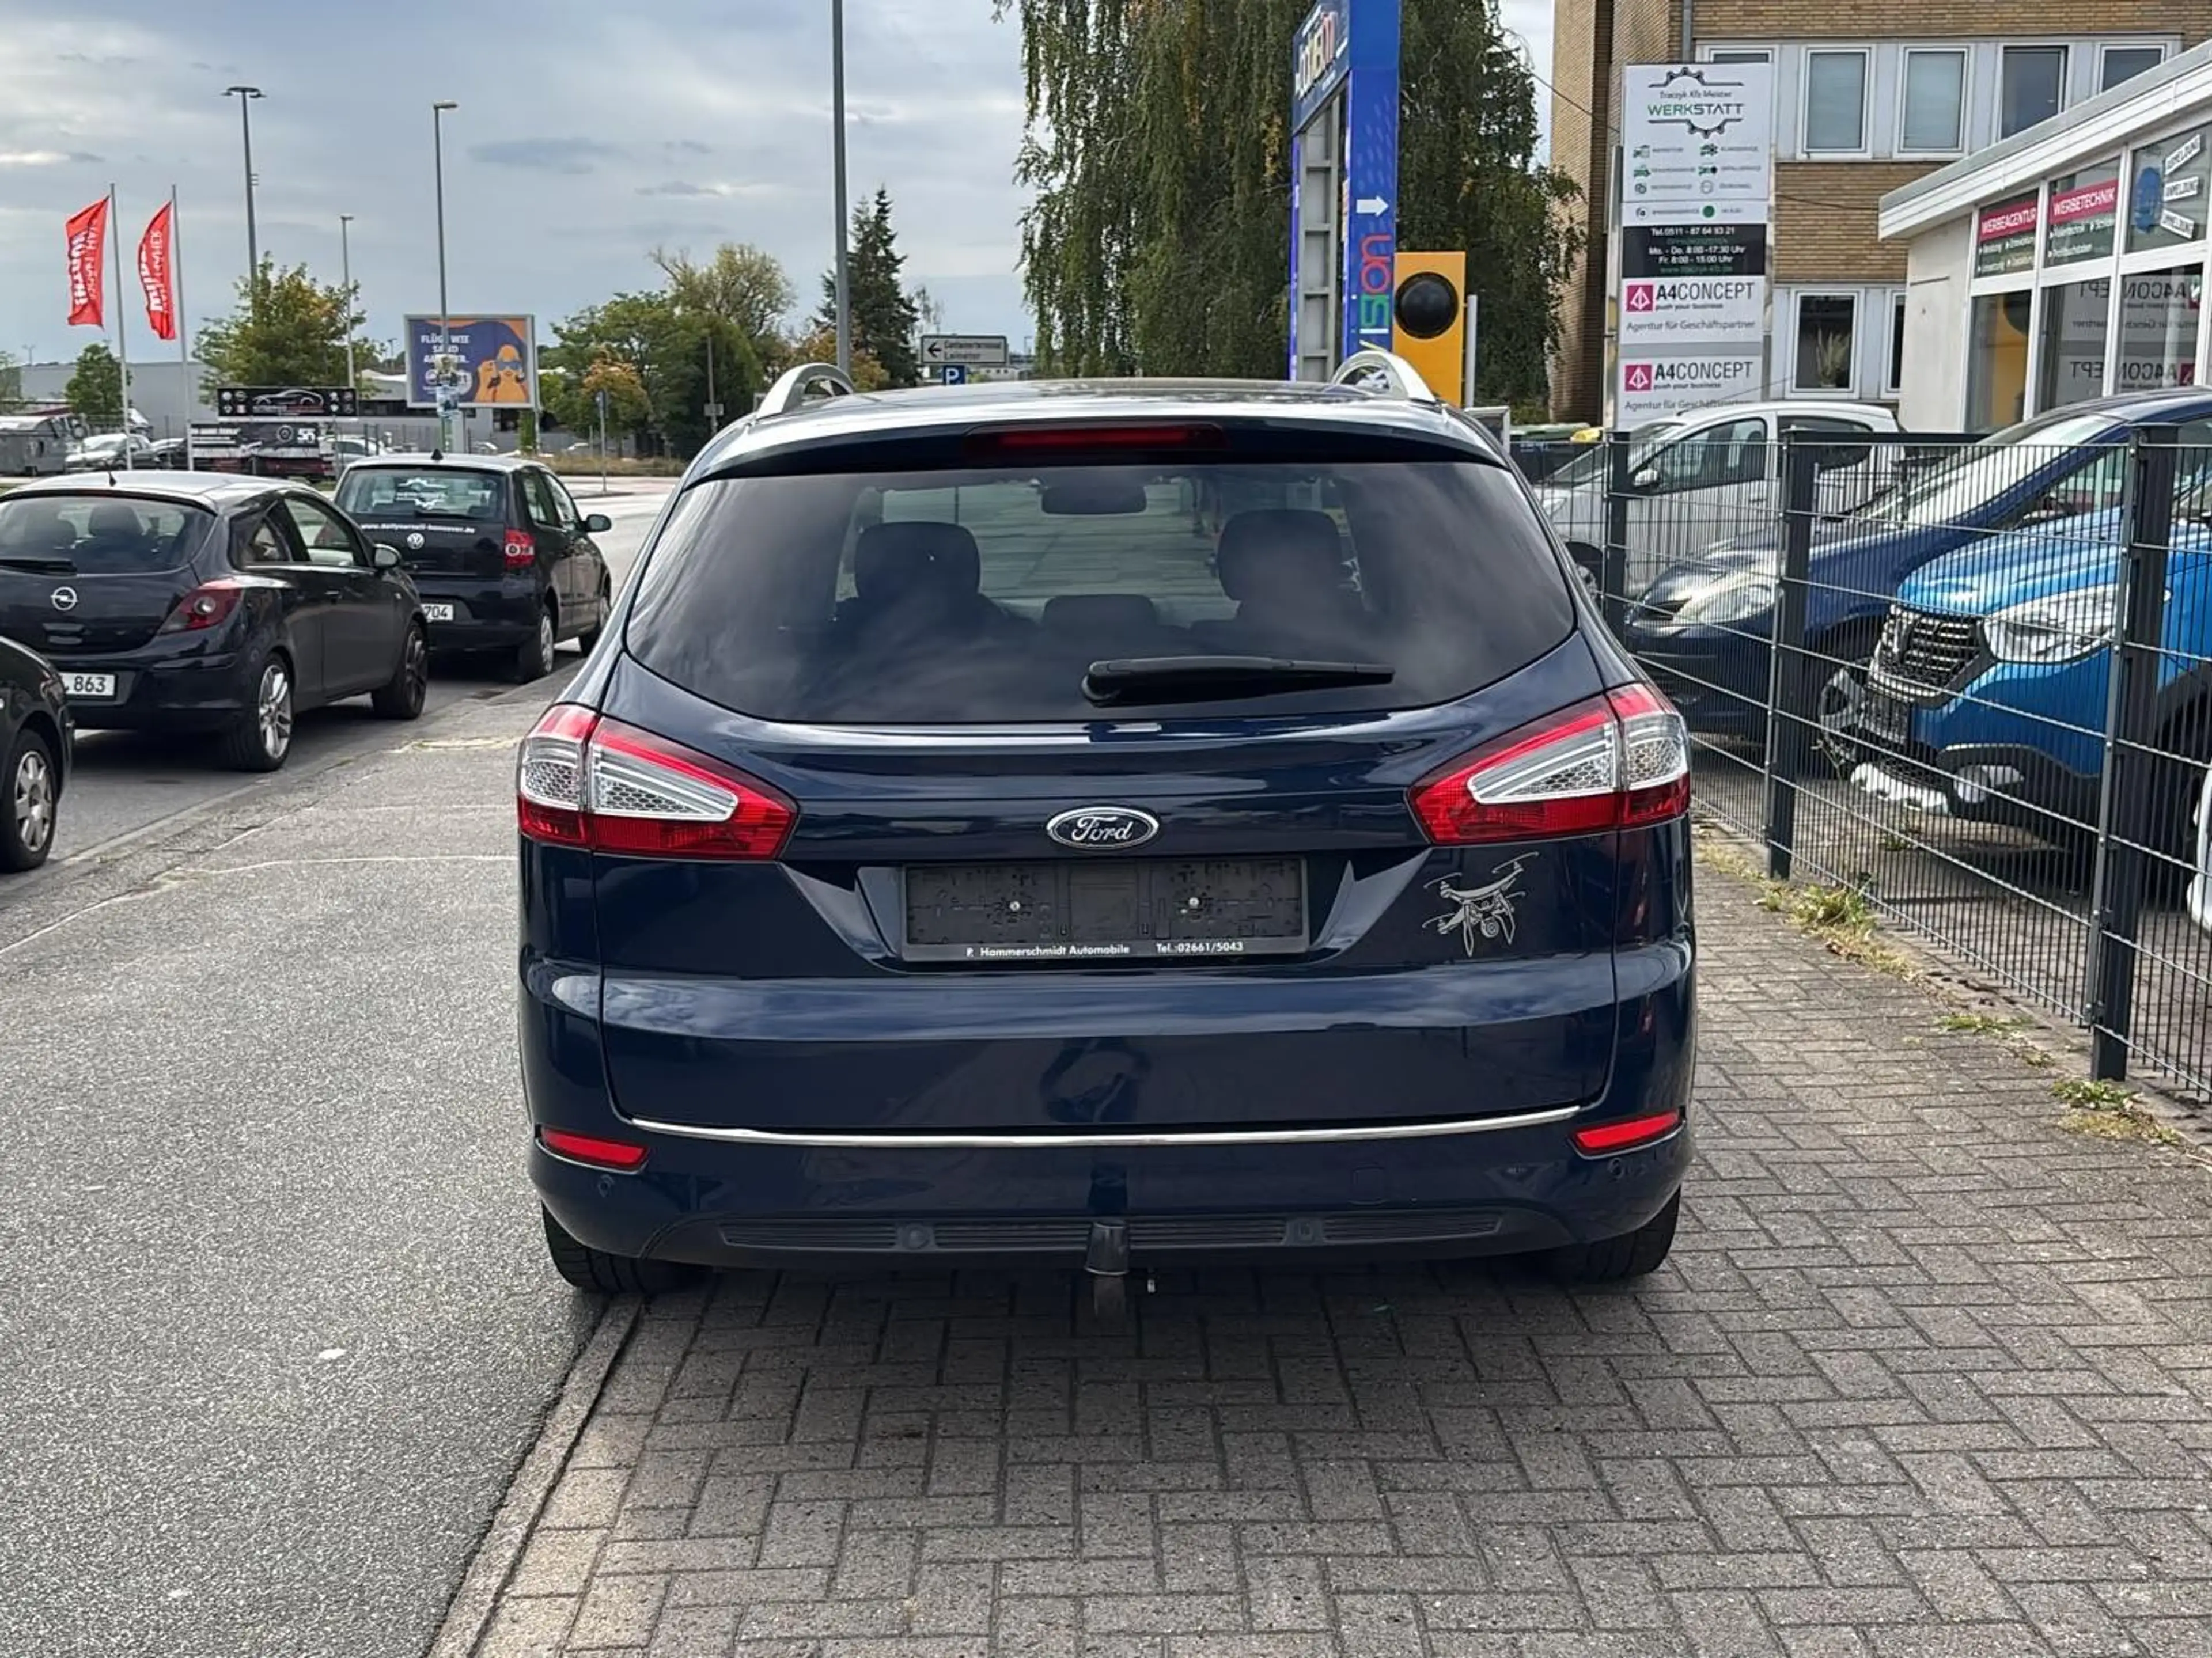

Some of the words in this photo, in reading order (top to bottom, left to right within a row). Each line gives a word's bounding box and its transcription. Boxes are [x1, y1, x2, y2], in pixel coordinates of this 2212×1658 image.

[1703, 90, 1732, 98] Meister
[1647, 103, 1744, 116] WERKSTATT
[2053, 187, 2115, 215] WERBETECHNIK
[1982, 207, 2036, 234] WERBEAGENTUR
[1730, 245, 1746, 253] Uhr
[1719, 255, 1733, 263] Uhr
[1656, 282, 1755, 301] A4CONCEPT
[1626, 321, 1662, 332] Agentur
[1665, 320, 1678, 329] für
[1680, 320, 1755, 330] Geschäftspartner
[421, 332, 444, 344] FLÜG
[946, 367, 959, 385] P
[1654, 361, 1753, 380] A4CONCEPT
[1624, 401, 1661, 412] Agentur
[424, 605, 448, 619] 704
[74, 675, 106, 693] 863
[1071, 816, 1134, 841] Ford
[980, 945, 1066, 957] Hammerschmidt
[1069, 944, 1130, 955] Automobile
